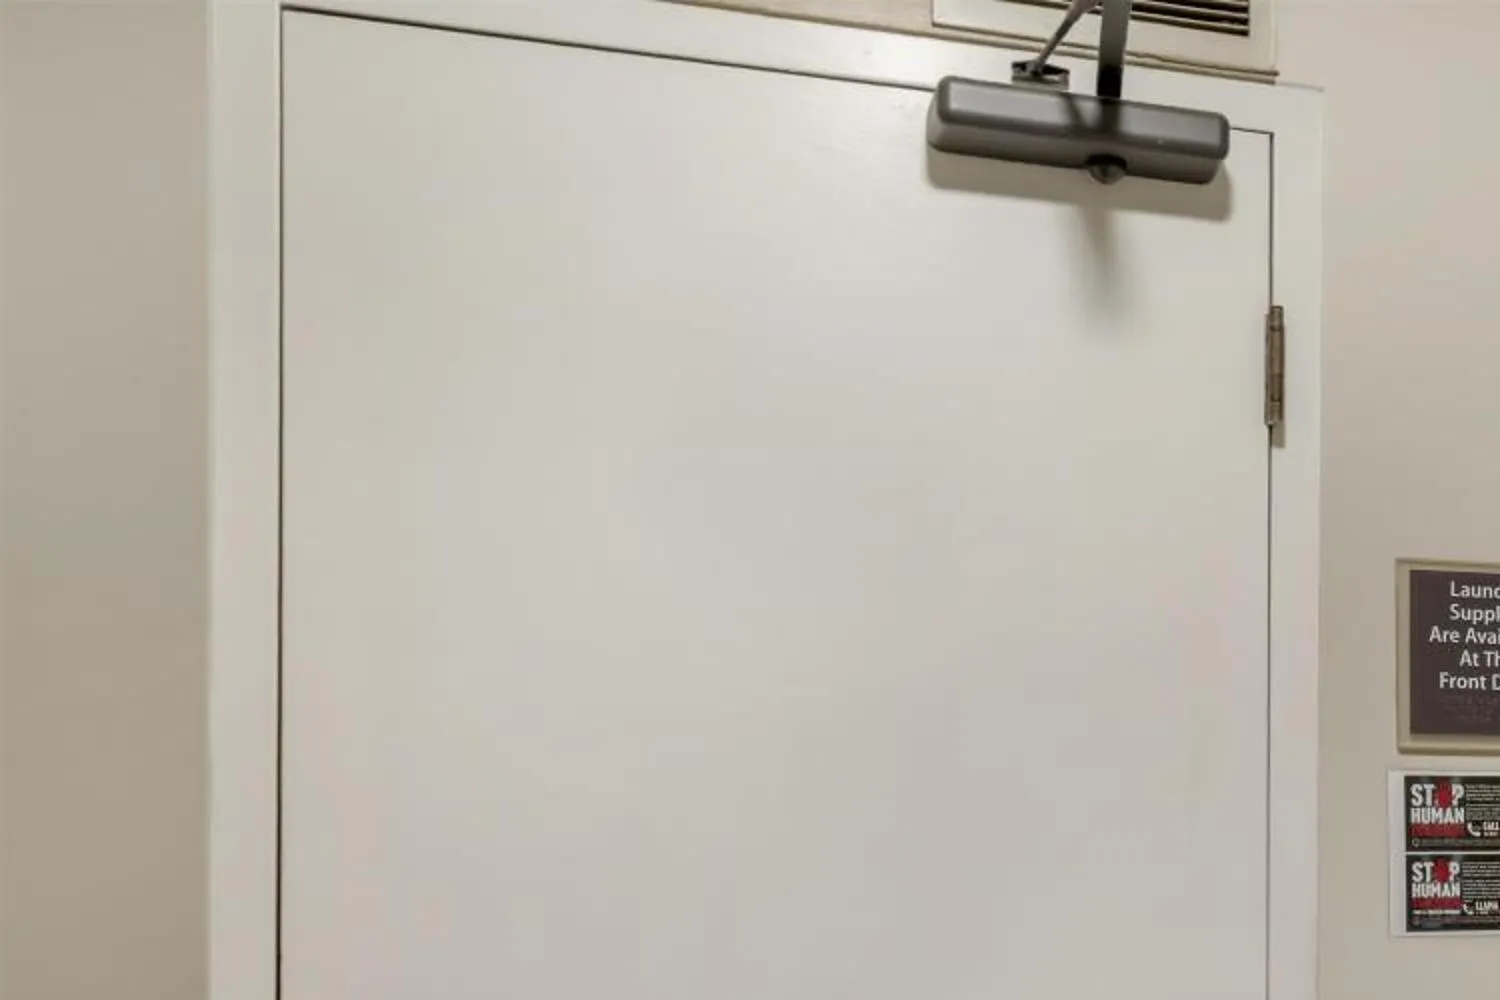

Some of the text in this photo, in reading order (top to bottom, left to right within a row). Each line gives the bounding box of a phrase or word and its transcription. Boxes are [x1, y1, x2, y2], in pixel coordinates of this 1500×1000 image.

[1429, 626, 1460, 644] Are
[1459, 650, 1480, 667] At
[1439, 671, 1486, 690] Front
[1411, 783, 1465, 807] STP
[1411, 807, 1465, 825] HUMAN
[1411, 861, 1460, 883] STP
[1411, 882, 1461, 898] HUMAN
